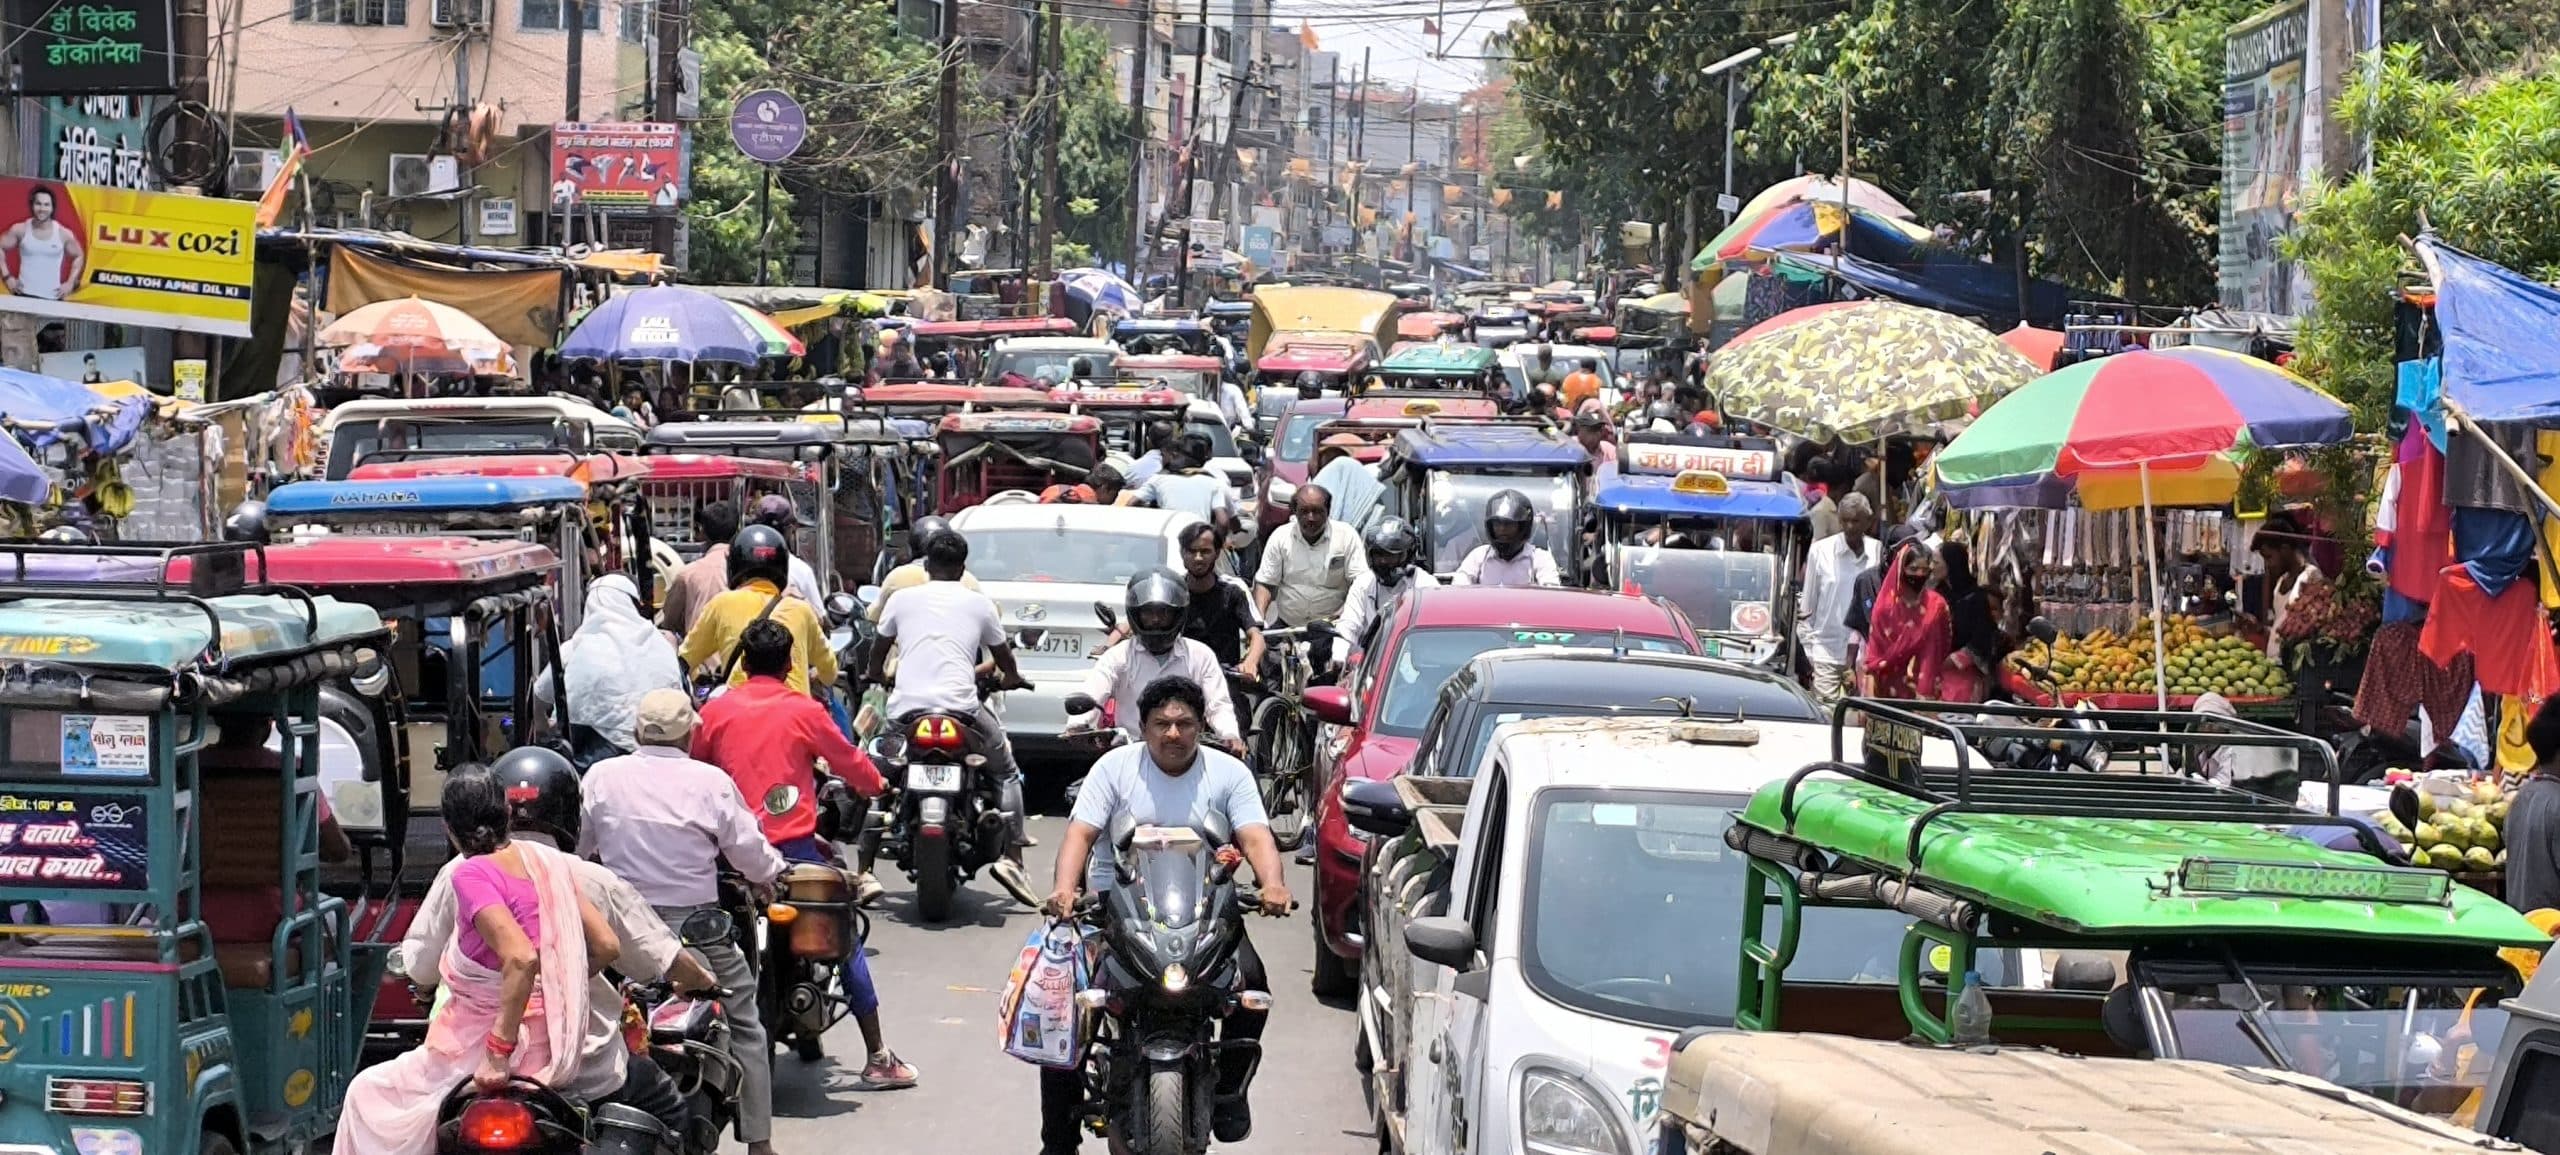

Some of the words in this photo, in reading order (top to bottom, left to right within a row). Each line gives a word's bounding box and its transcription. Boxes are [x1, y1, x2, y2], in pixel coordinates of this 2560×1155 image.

[78, 4, 137, 31] विवेक
[46, 36, 143, 65] डोकानिया
[99, 224, 172, 248] LUX
[177, 229, 241, 256] cozi
[98, 272, 134, 285] SUNO
[135, 276, 162, 288] TOH
[164, 281, 199, 293] APNE
[202, 285, 222, 295] DIL
[225, 286, 239, 297] KI
[1638, 451, 1678, 469] जय
[1684, 453, 1735, 474] माता
[1741, 452, 1768, 477] दी
[1513, 631, 1576, 643] 707
